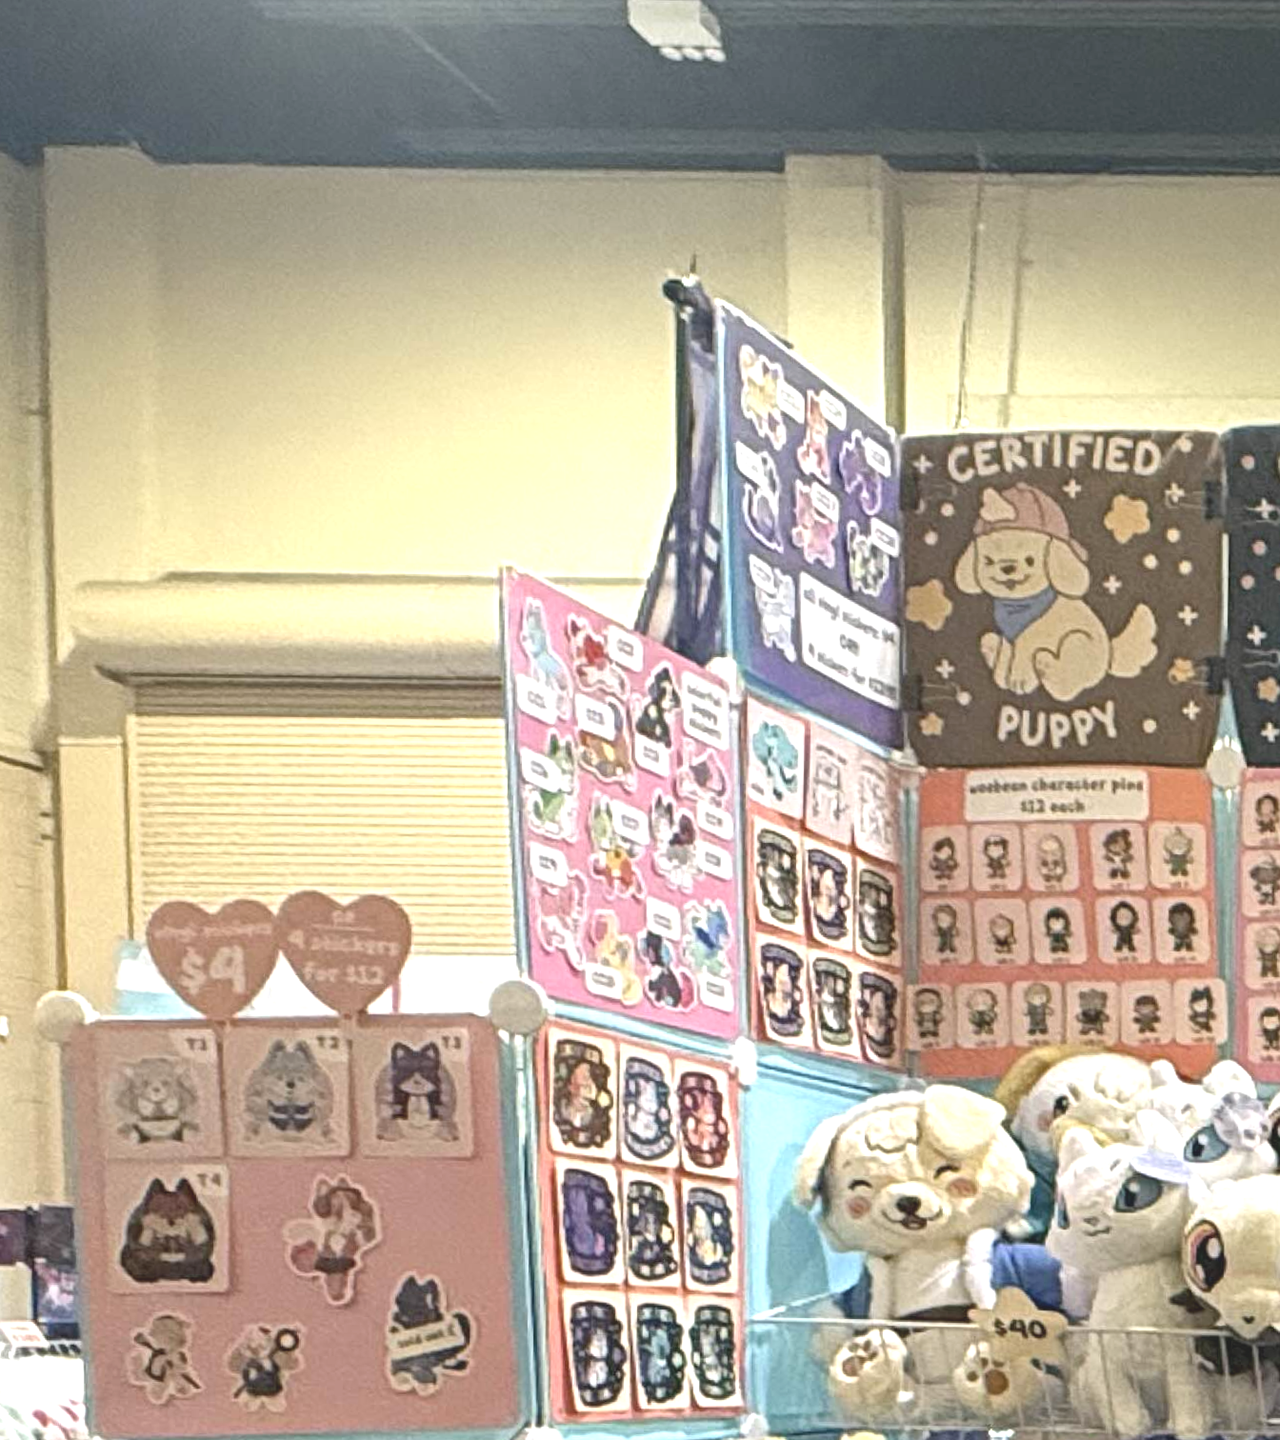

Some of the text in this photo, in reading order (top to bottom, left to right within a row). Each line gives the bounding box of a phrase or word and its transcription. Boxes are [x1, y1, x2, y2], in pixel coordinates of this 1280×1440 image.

[947, 435, 1161, 482] CERTIFIED
[998, 702, 1115, 747] PUPPY
[992, 1316, 1047, 1341] $40
